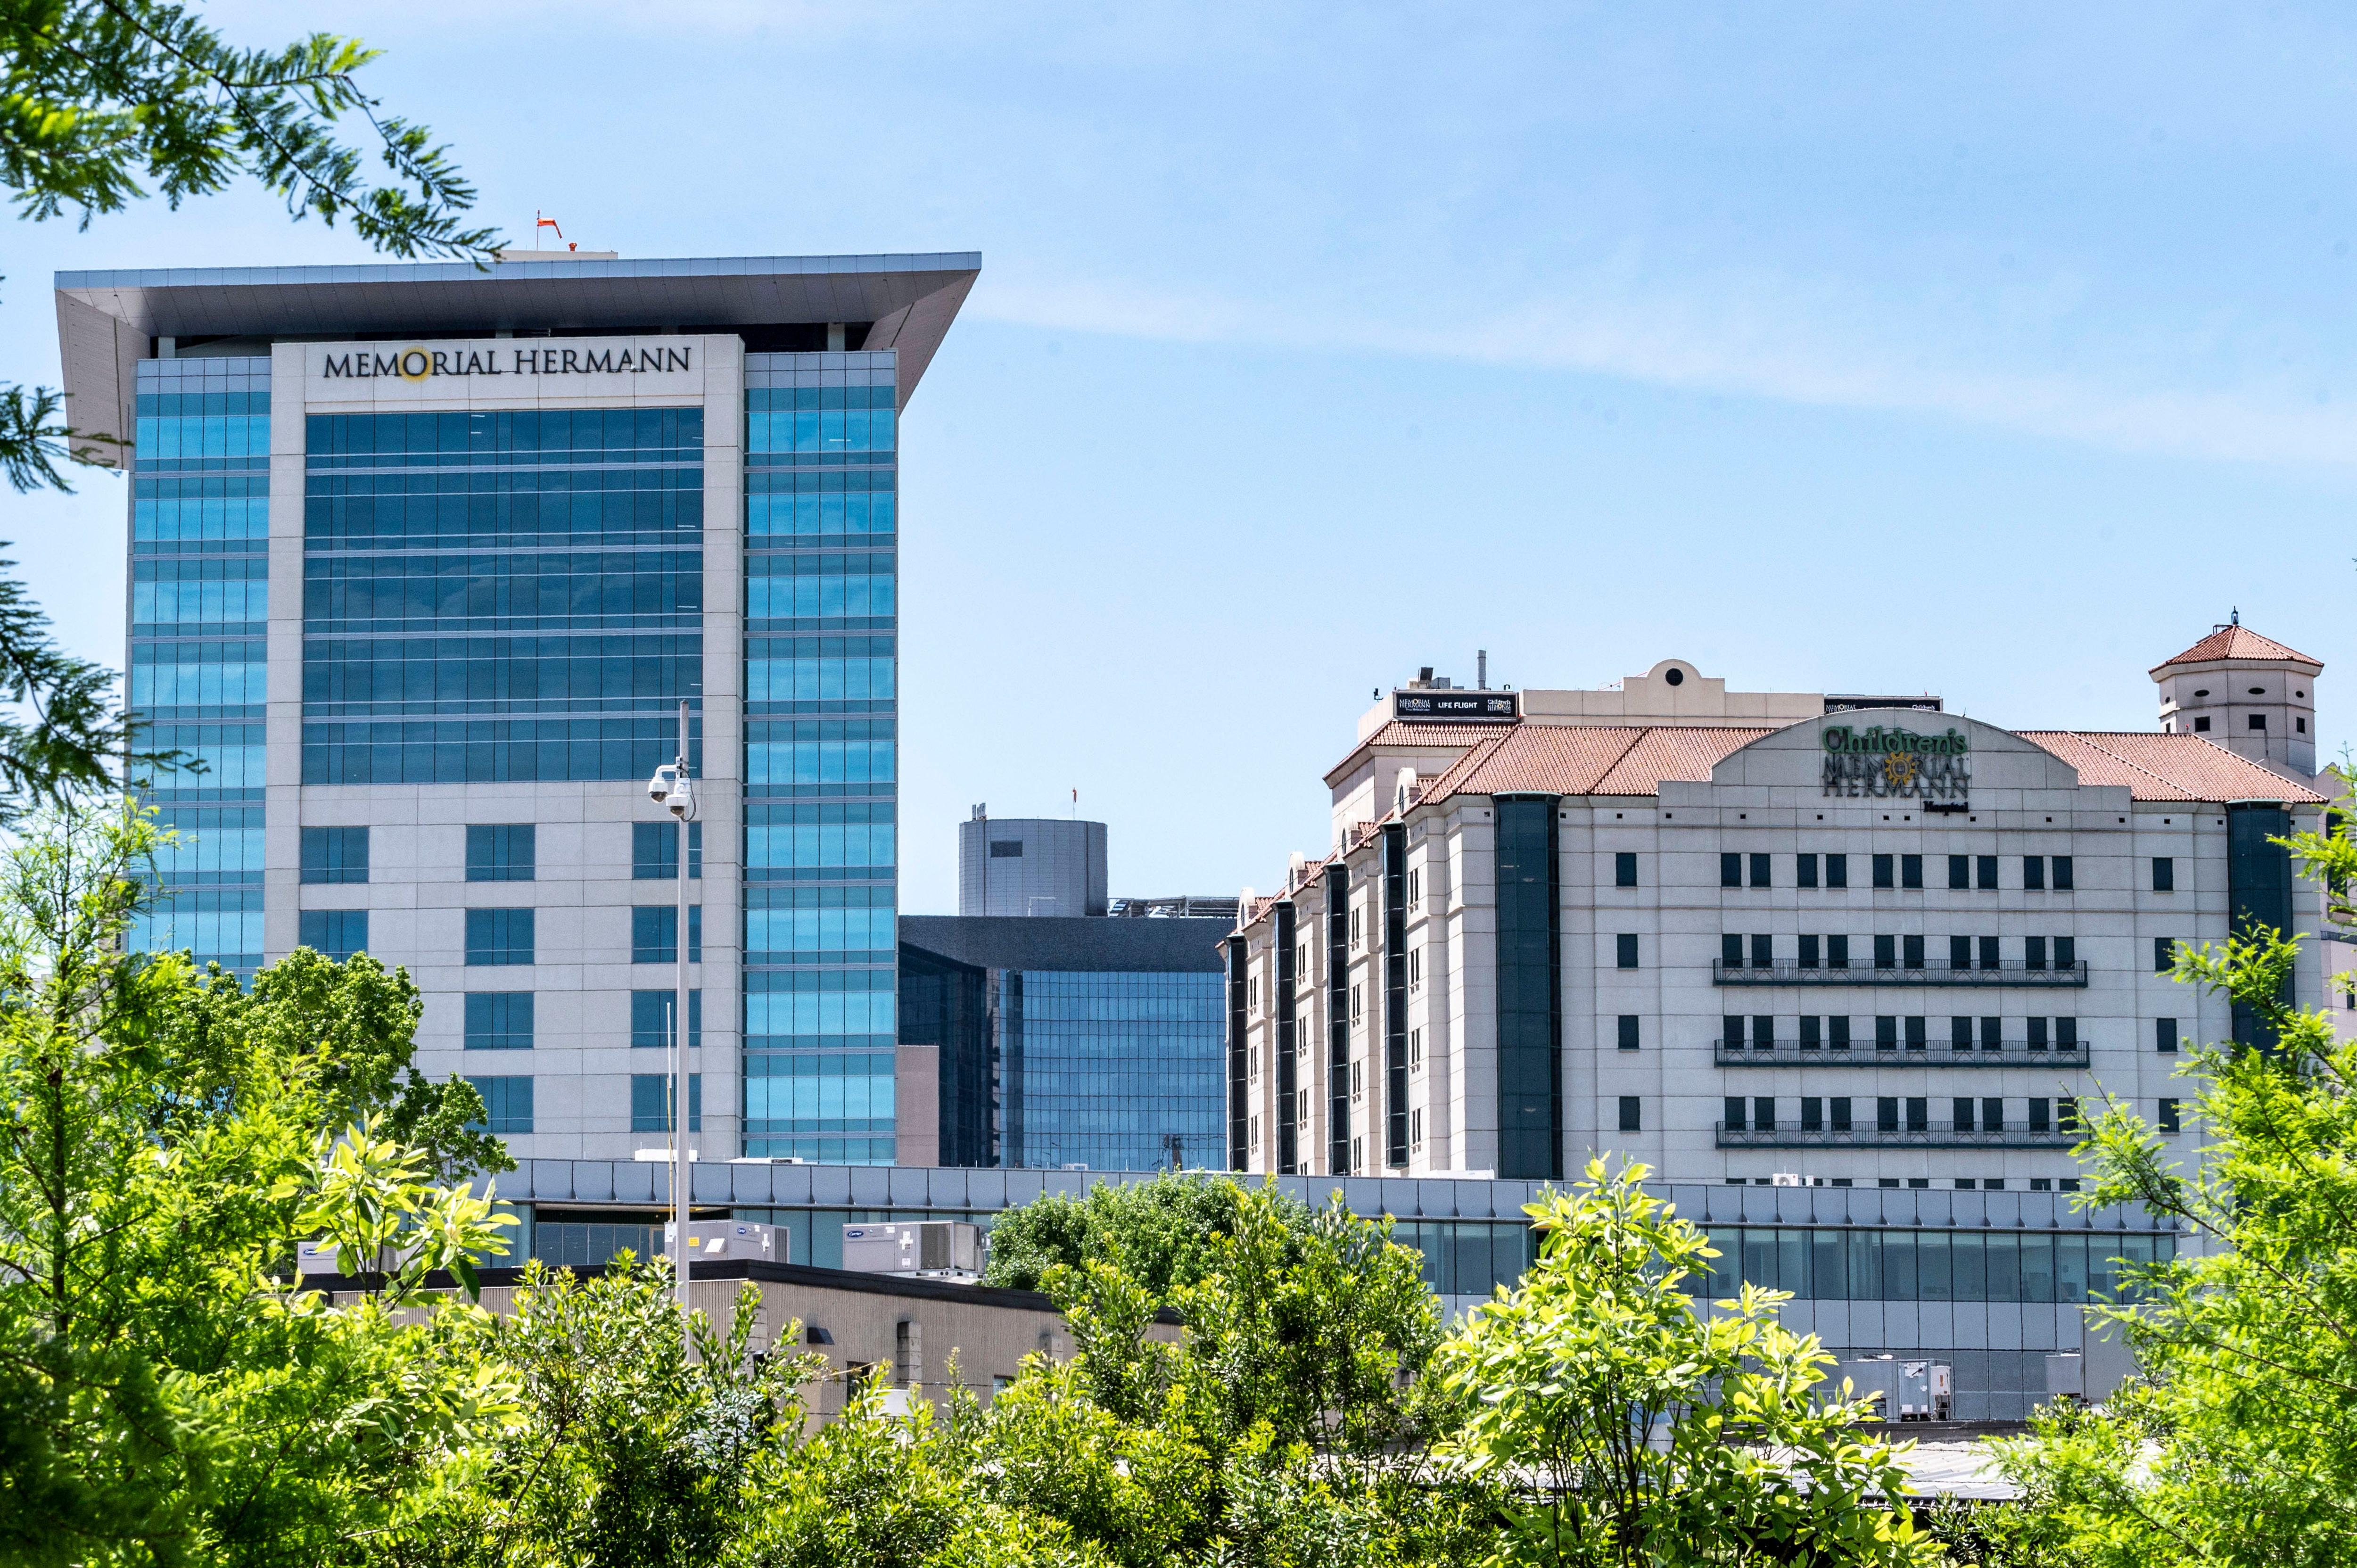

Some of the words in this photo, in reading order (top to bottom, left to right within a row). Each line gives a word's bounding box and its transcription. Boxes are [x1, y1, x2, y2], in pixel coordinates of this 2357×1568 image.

[324, 351, 501, 377] MEMORIAL
[514, 347, 691, 374] HERMANN
[1822, 725, 1968, 755] Children's
[1822, 755, 1970, 779] MEMORIAL
[1823, 776, 1969, 798] HERMANN
